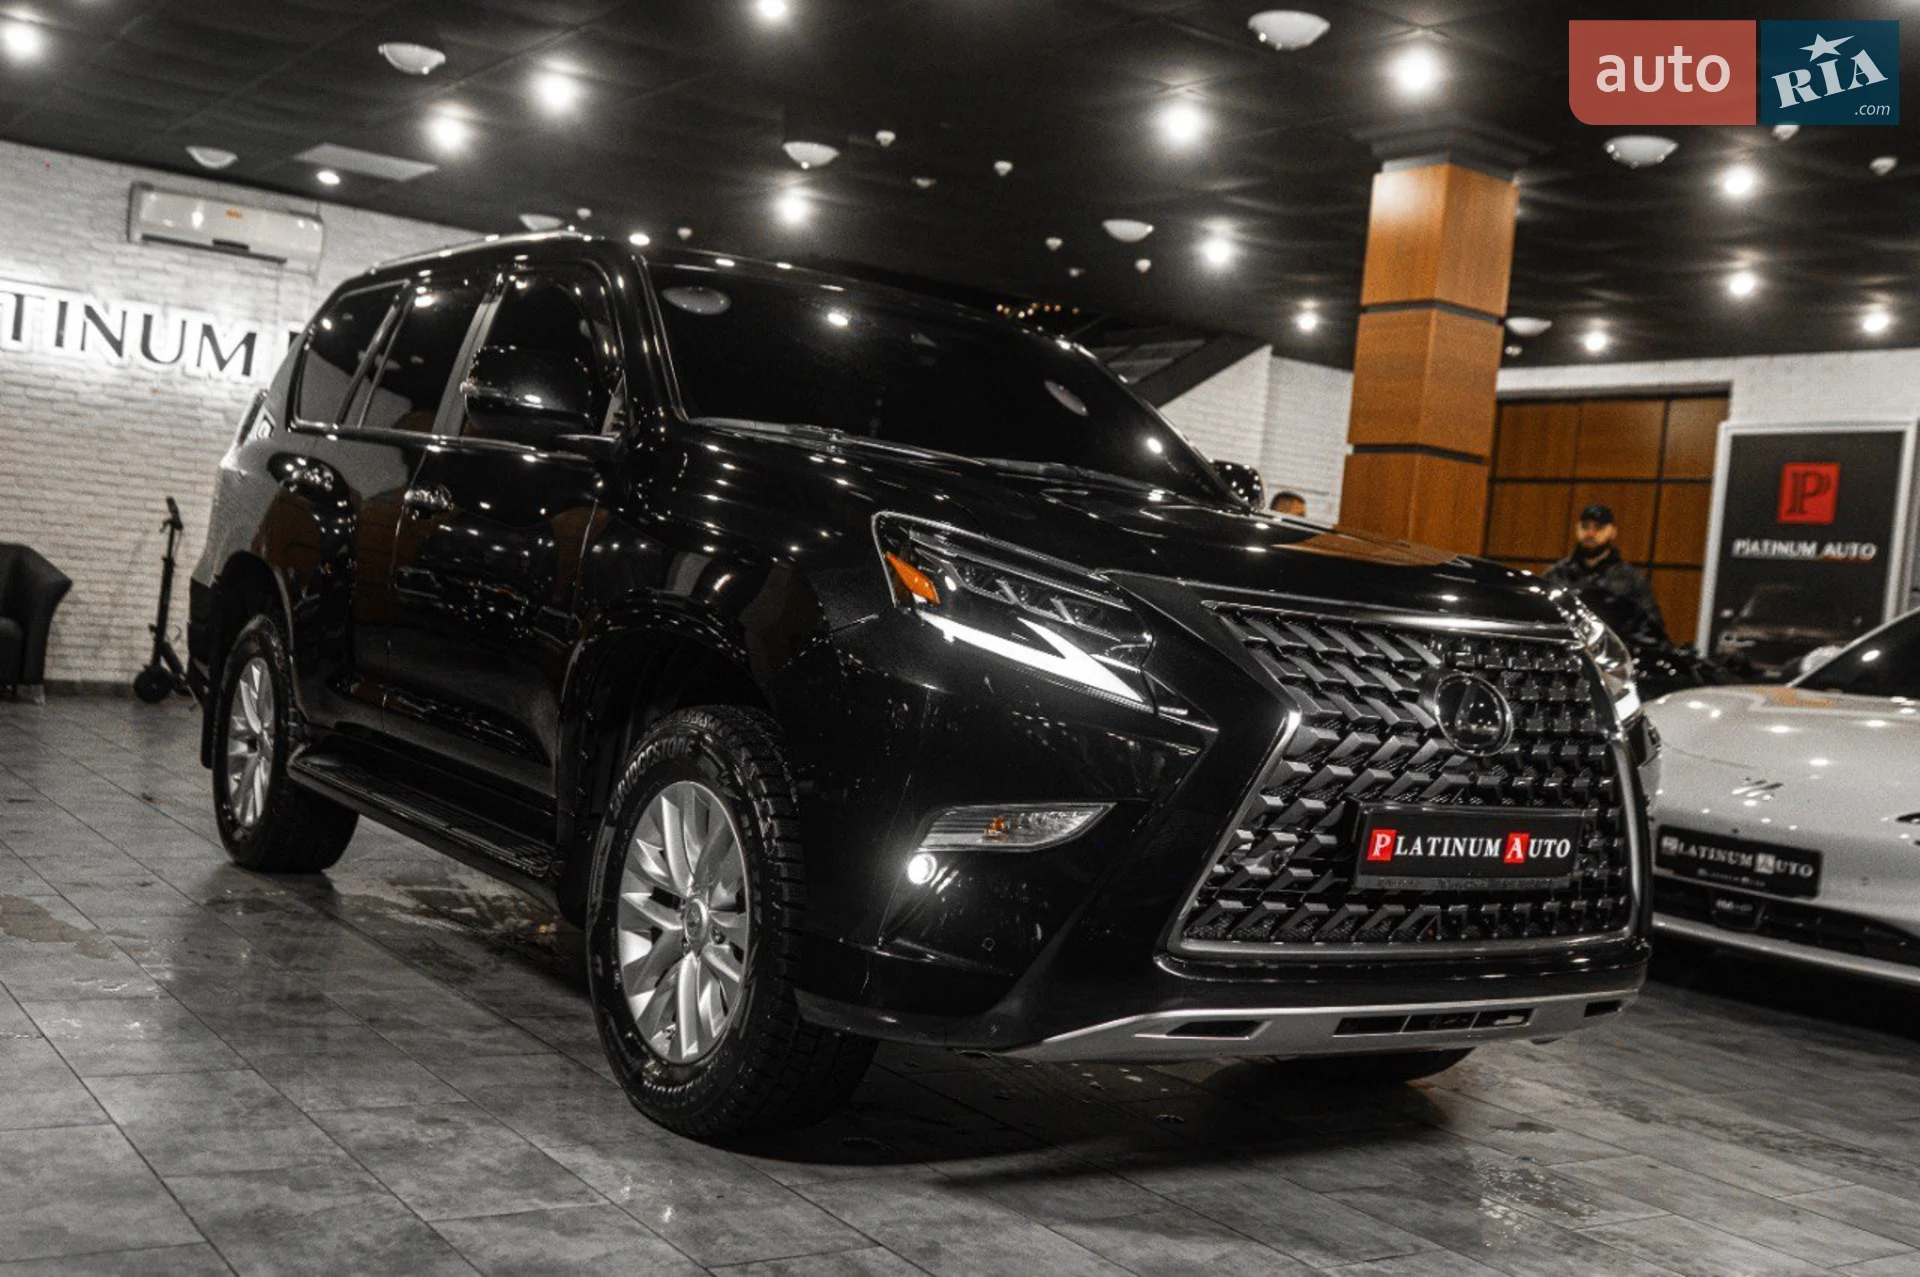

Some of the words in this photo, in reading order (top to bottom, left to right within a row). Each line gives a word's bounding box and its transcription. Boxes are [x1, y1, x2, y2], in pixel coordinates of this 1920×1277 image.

[1731, 538, 1817, 559] PLATINUM
[1819, 542, 1877, 561] AUTO
[1371, 832, 1501, 857] PLATINUM
[1505, 835, 1571, 859] AUTO
